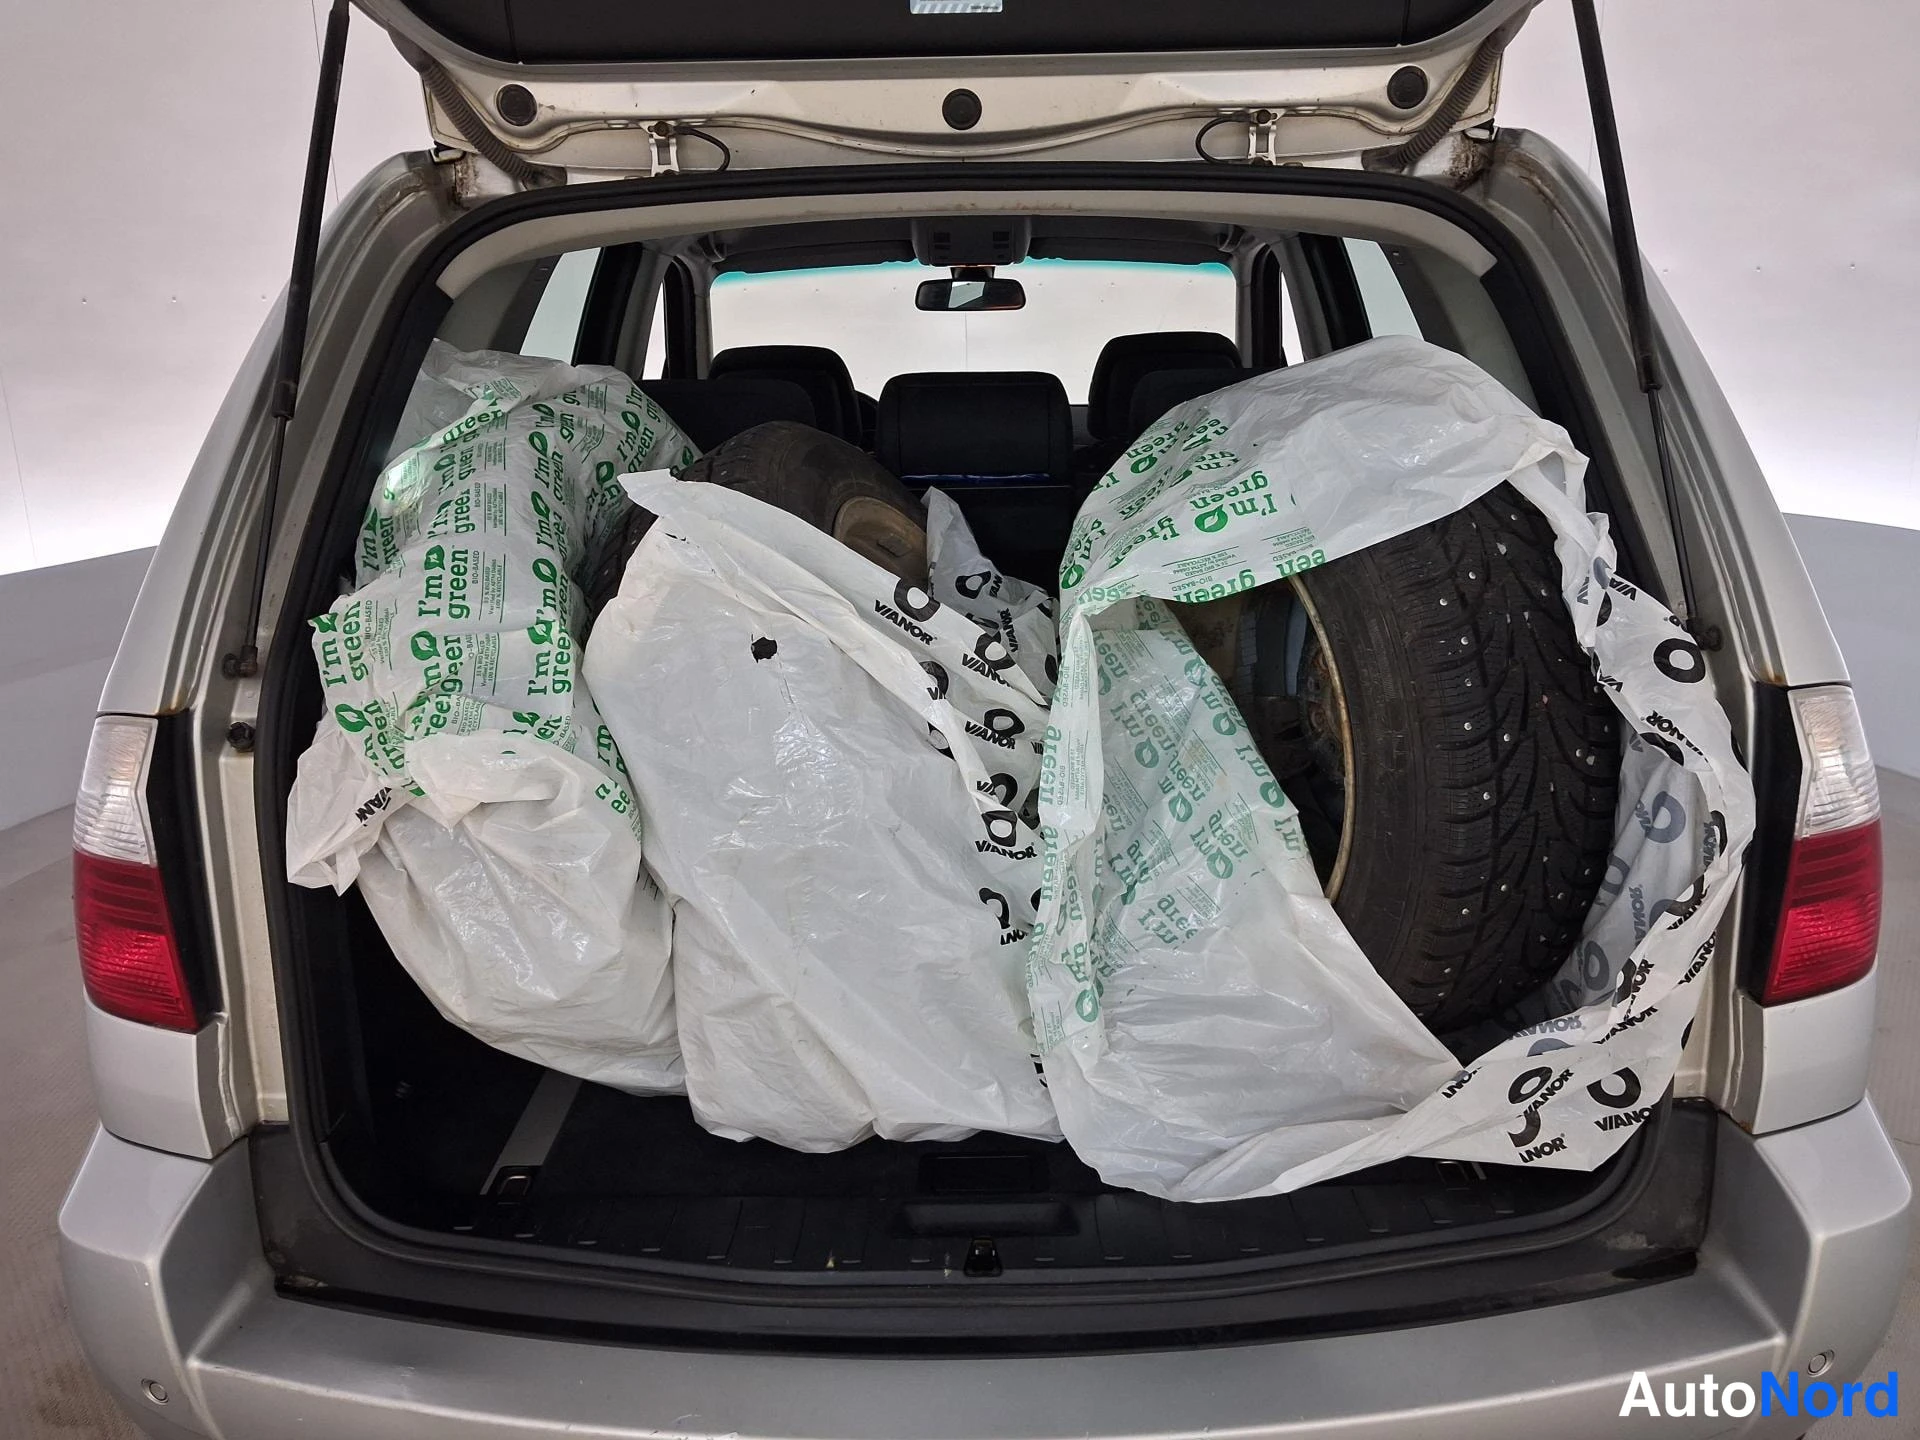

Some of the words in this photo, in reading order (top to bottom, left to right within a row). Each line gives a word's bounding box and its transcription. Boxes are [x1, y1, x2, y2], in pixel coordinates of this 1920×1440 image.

[1190, 471, 1268, 510] green
[1229, 494, 1278, 516] I'm
[361, 537, 379, 572] I'm
[472, 550, 480, 584] BIO-BASED
[418, 574, 442, 617] I'm
[449, 548, 470, 620] green
[874, 600, 933, 646] VIANOR
[322, 638, 347, 688] I'm
[528, 650, 551, 696] I'm
[965, 721, 1015, 749] VIANOR
[975, 840, 1037, 860] VIANOR
[1594, 1107, 1652, 1132] VIANO
